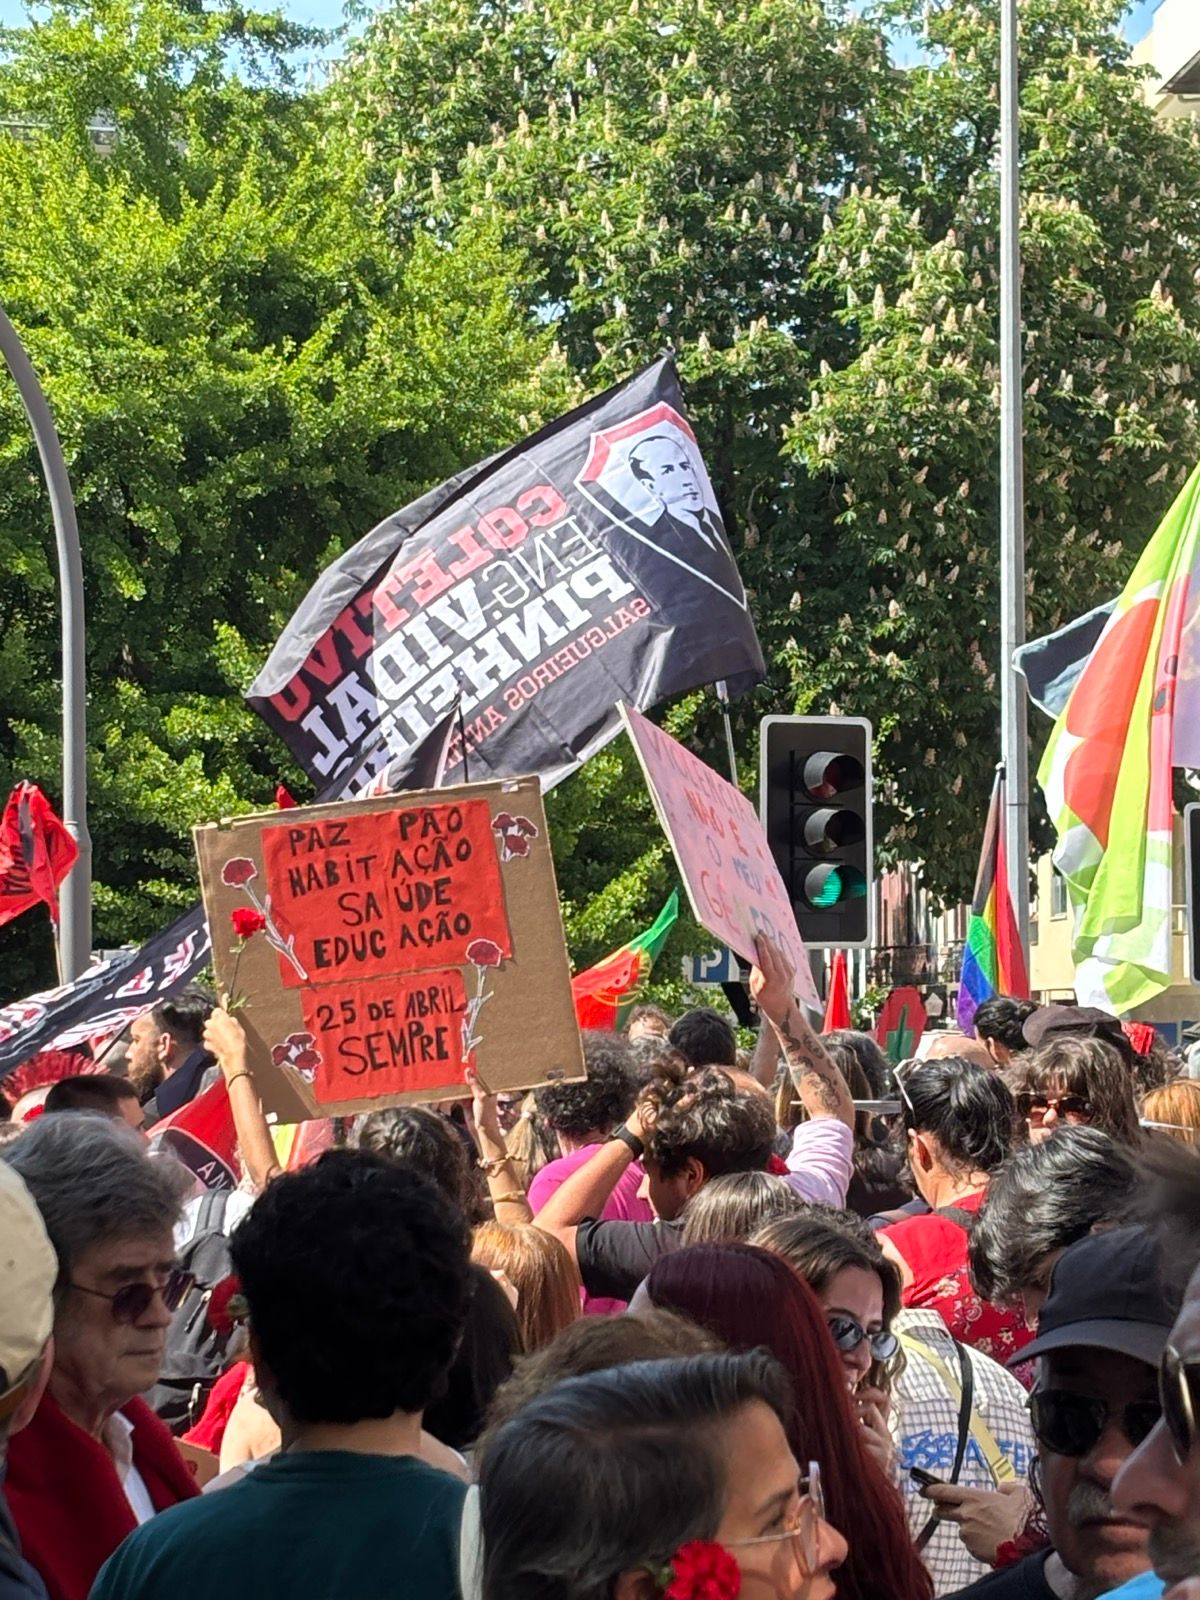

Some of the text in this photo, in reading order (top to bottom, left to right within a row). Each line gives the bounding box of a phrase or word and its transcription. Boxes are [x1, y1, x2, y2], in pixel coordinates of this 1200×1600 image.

[288, 806, 463, 857] PAZ PÃO
[706, 834, 722, 867] O
[316, 999, 357, 1032] 25
[367, 999, 396, 1022] DE
[338, 1020, 450, 1076] SEMPRE
